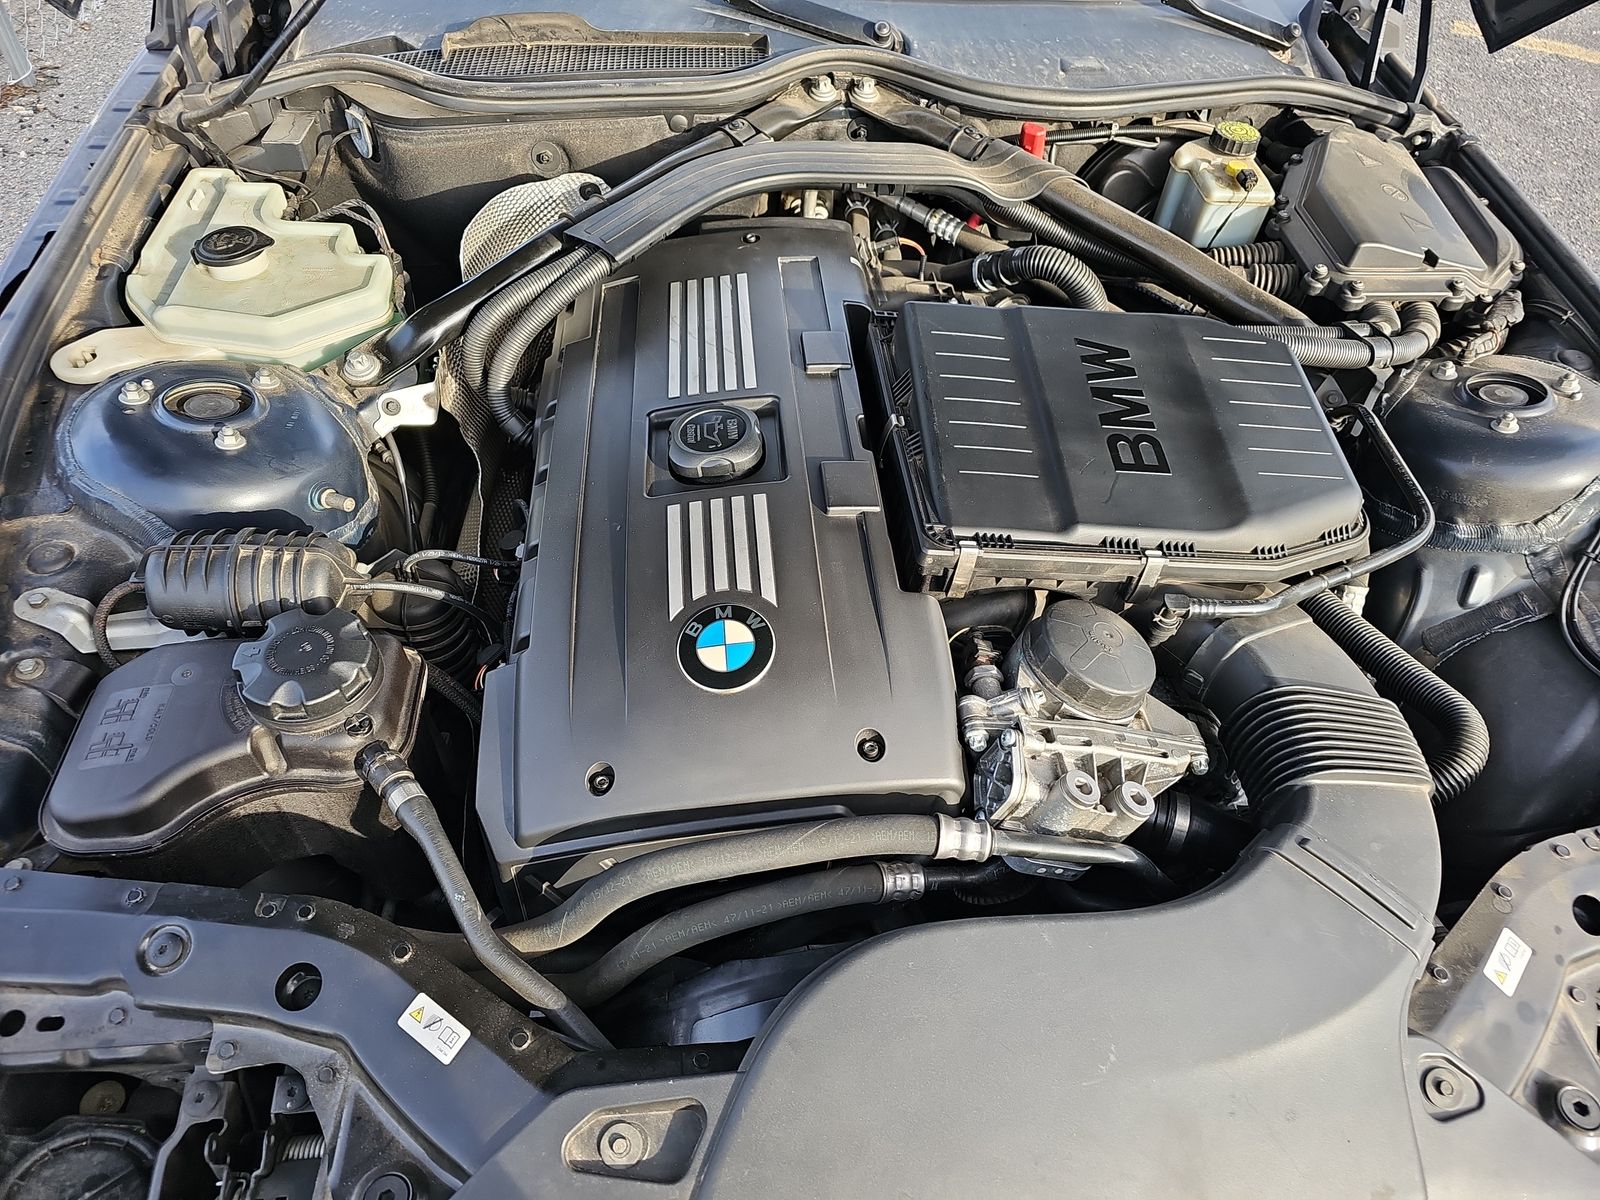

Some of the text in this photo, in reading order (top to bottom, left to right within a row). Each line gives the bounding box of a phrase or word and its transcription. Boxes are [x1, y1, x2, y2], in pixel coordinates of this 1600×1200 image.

[1074, 337, 1173, 476] BMW
[727, 418, 739, 440] BMW
[685, 605, 766, 638] BMW
